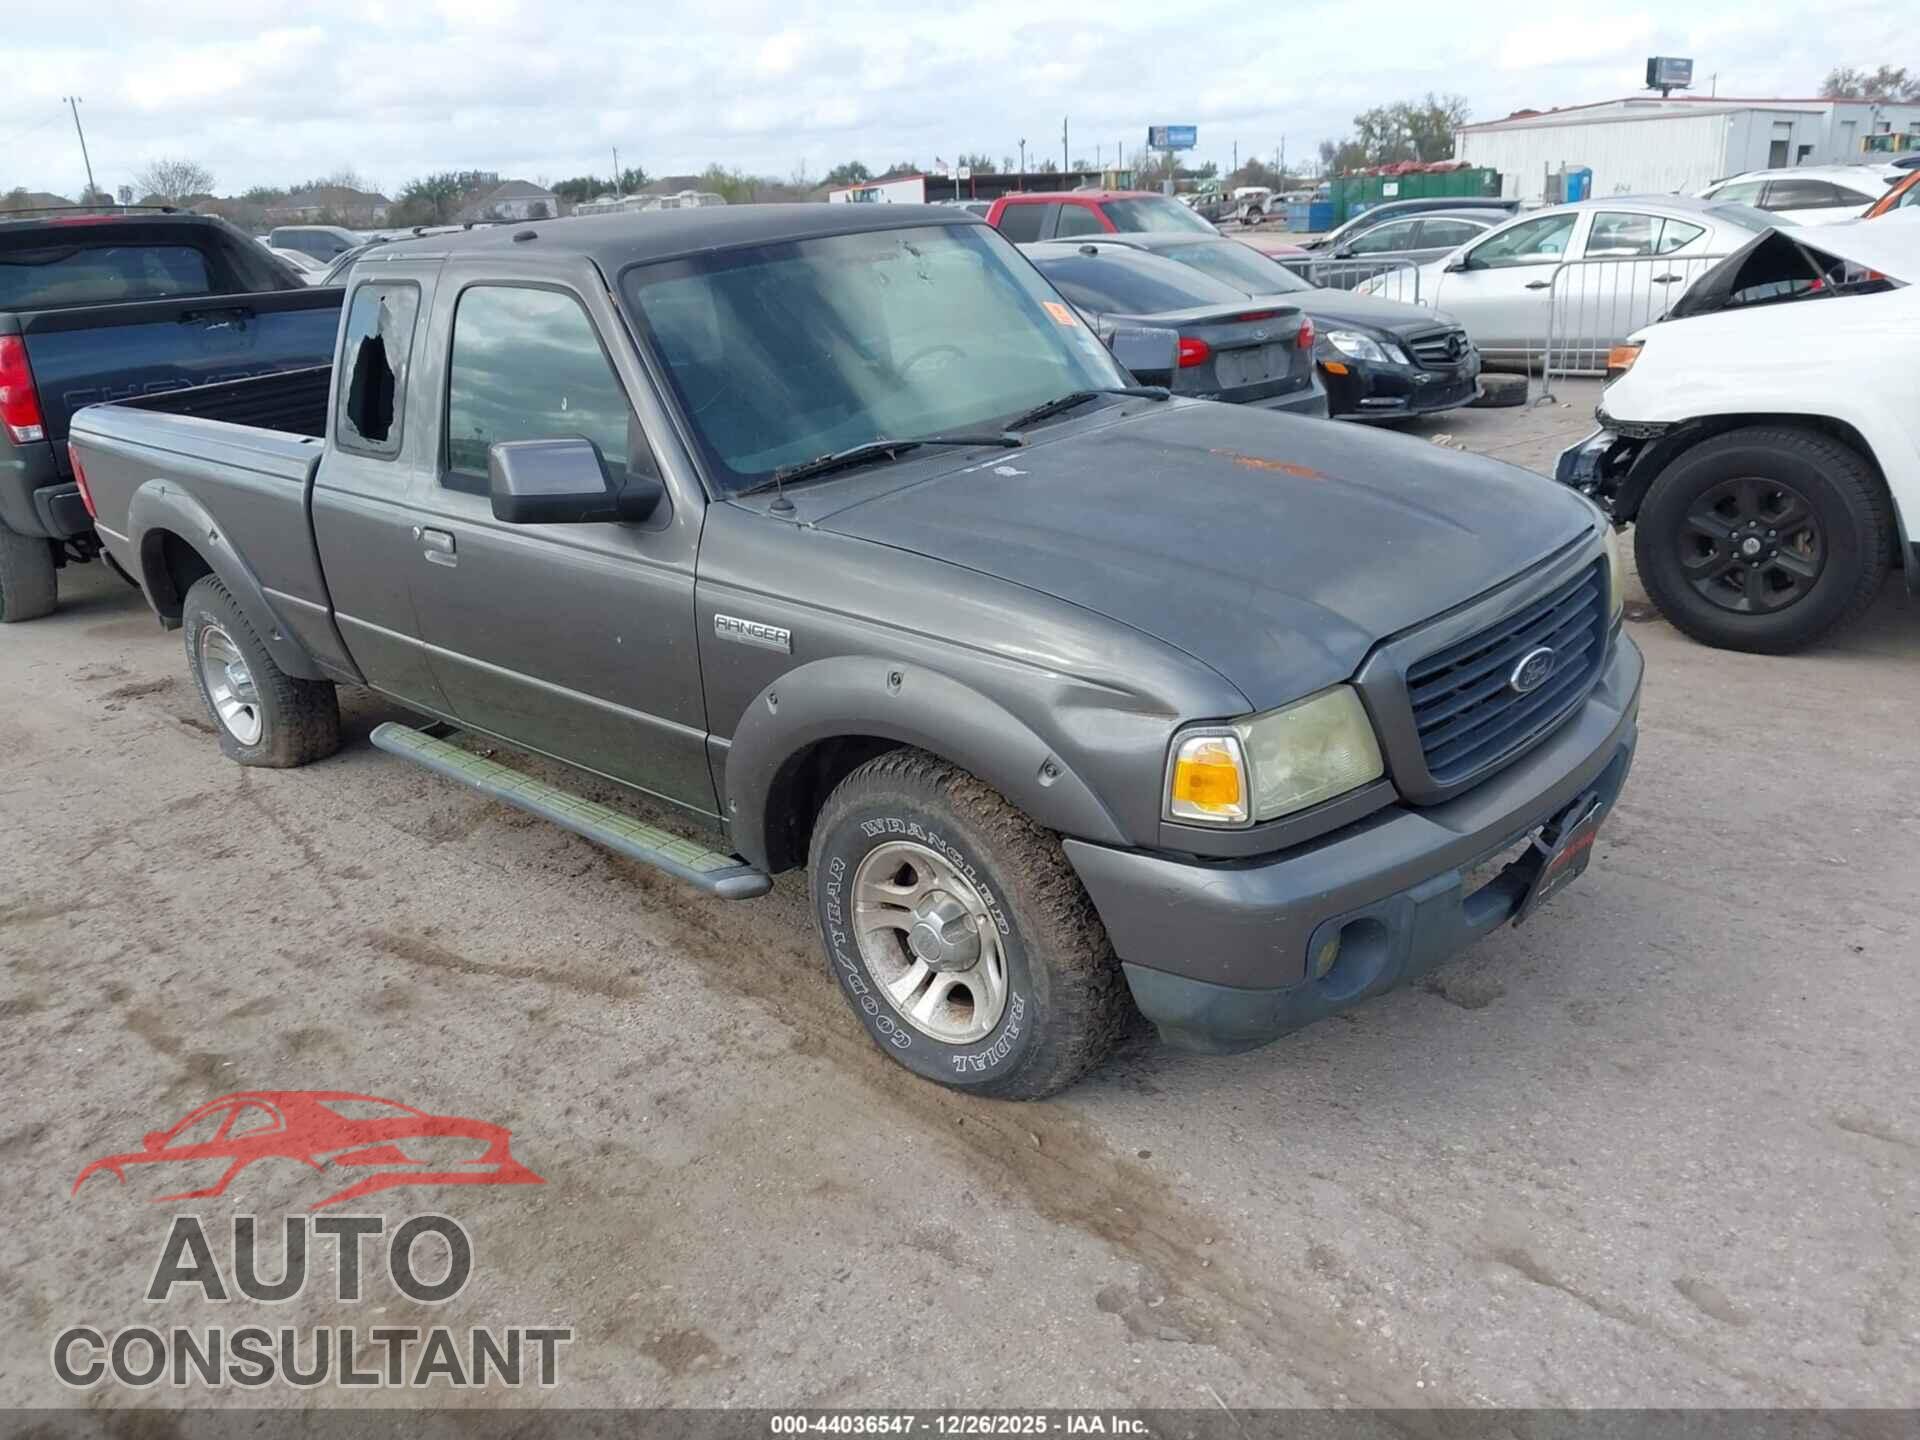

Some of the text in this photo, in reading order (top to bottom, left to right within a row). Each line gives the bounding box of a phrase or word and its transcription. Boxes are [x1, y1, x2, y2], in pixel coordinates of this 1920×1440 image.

[716, 616, 788, 644] RANGER
[860, 817, 1010, 935] WRANGLER
[952, 991, 1025, 1073] RADIAL
